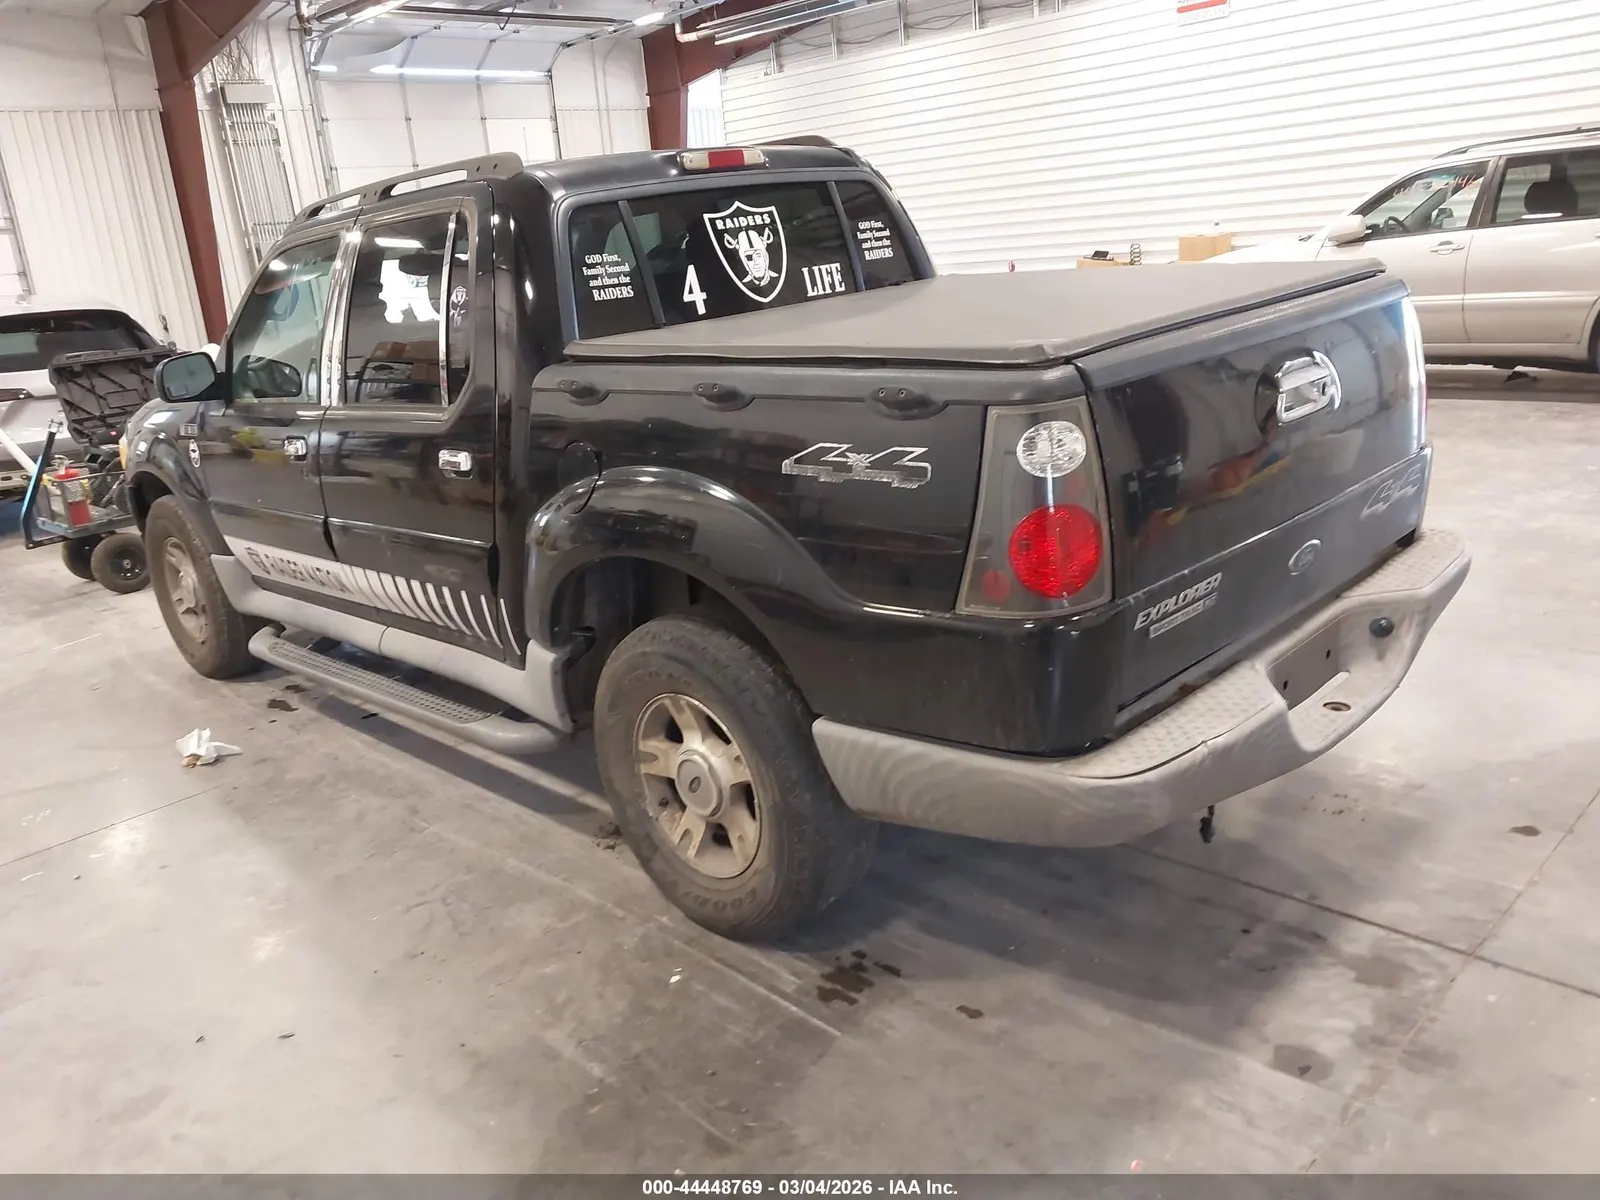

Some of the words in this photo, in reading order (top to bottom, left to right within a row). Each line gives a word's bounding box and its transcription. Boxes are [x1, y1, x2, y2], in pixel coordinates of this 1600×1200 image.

[715, 213, 771, 230] RAIDERS
[858, 221, 870, 230] GOD
[584, 253, 602, 264] GOD
[602, 253, 622, 262] First,
[864, 247, 893, 260] RAIDERS
[581, 265, 606, 276] Family
[605, 262, 631, 273] Second
[588, 276, 603, 287] and
[602, 275, 619, 285] then
[618, 273, 631, 283] the
[592, 285, 634, 301] RAIDERS
[683, 264, 707, 315] 4
[801, 262, 846, 297] LIFE
[1133, 571, 1223, 631] EXPLORER
